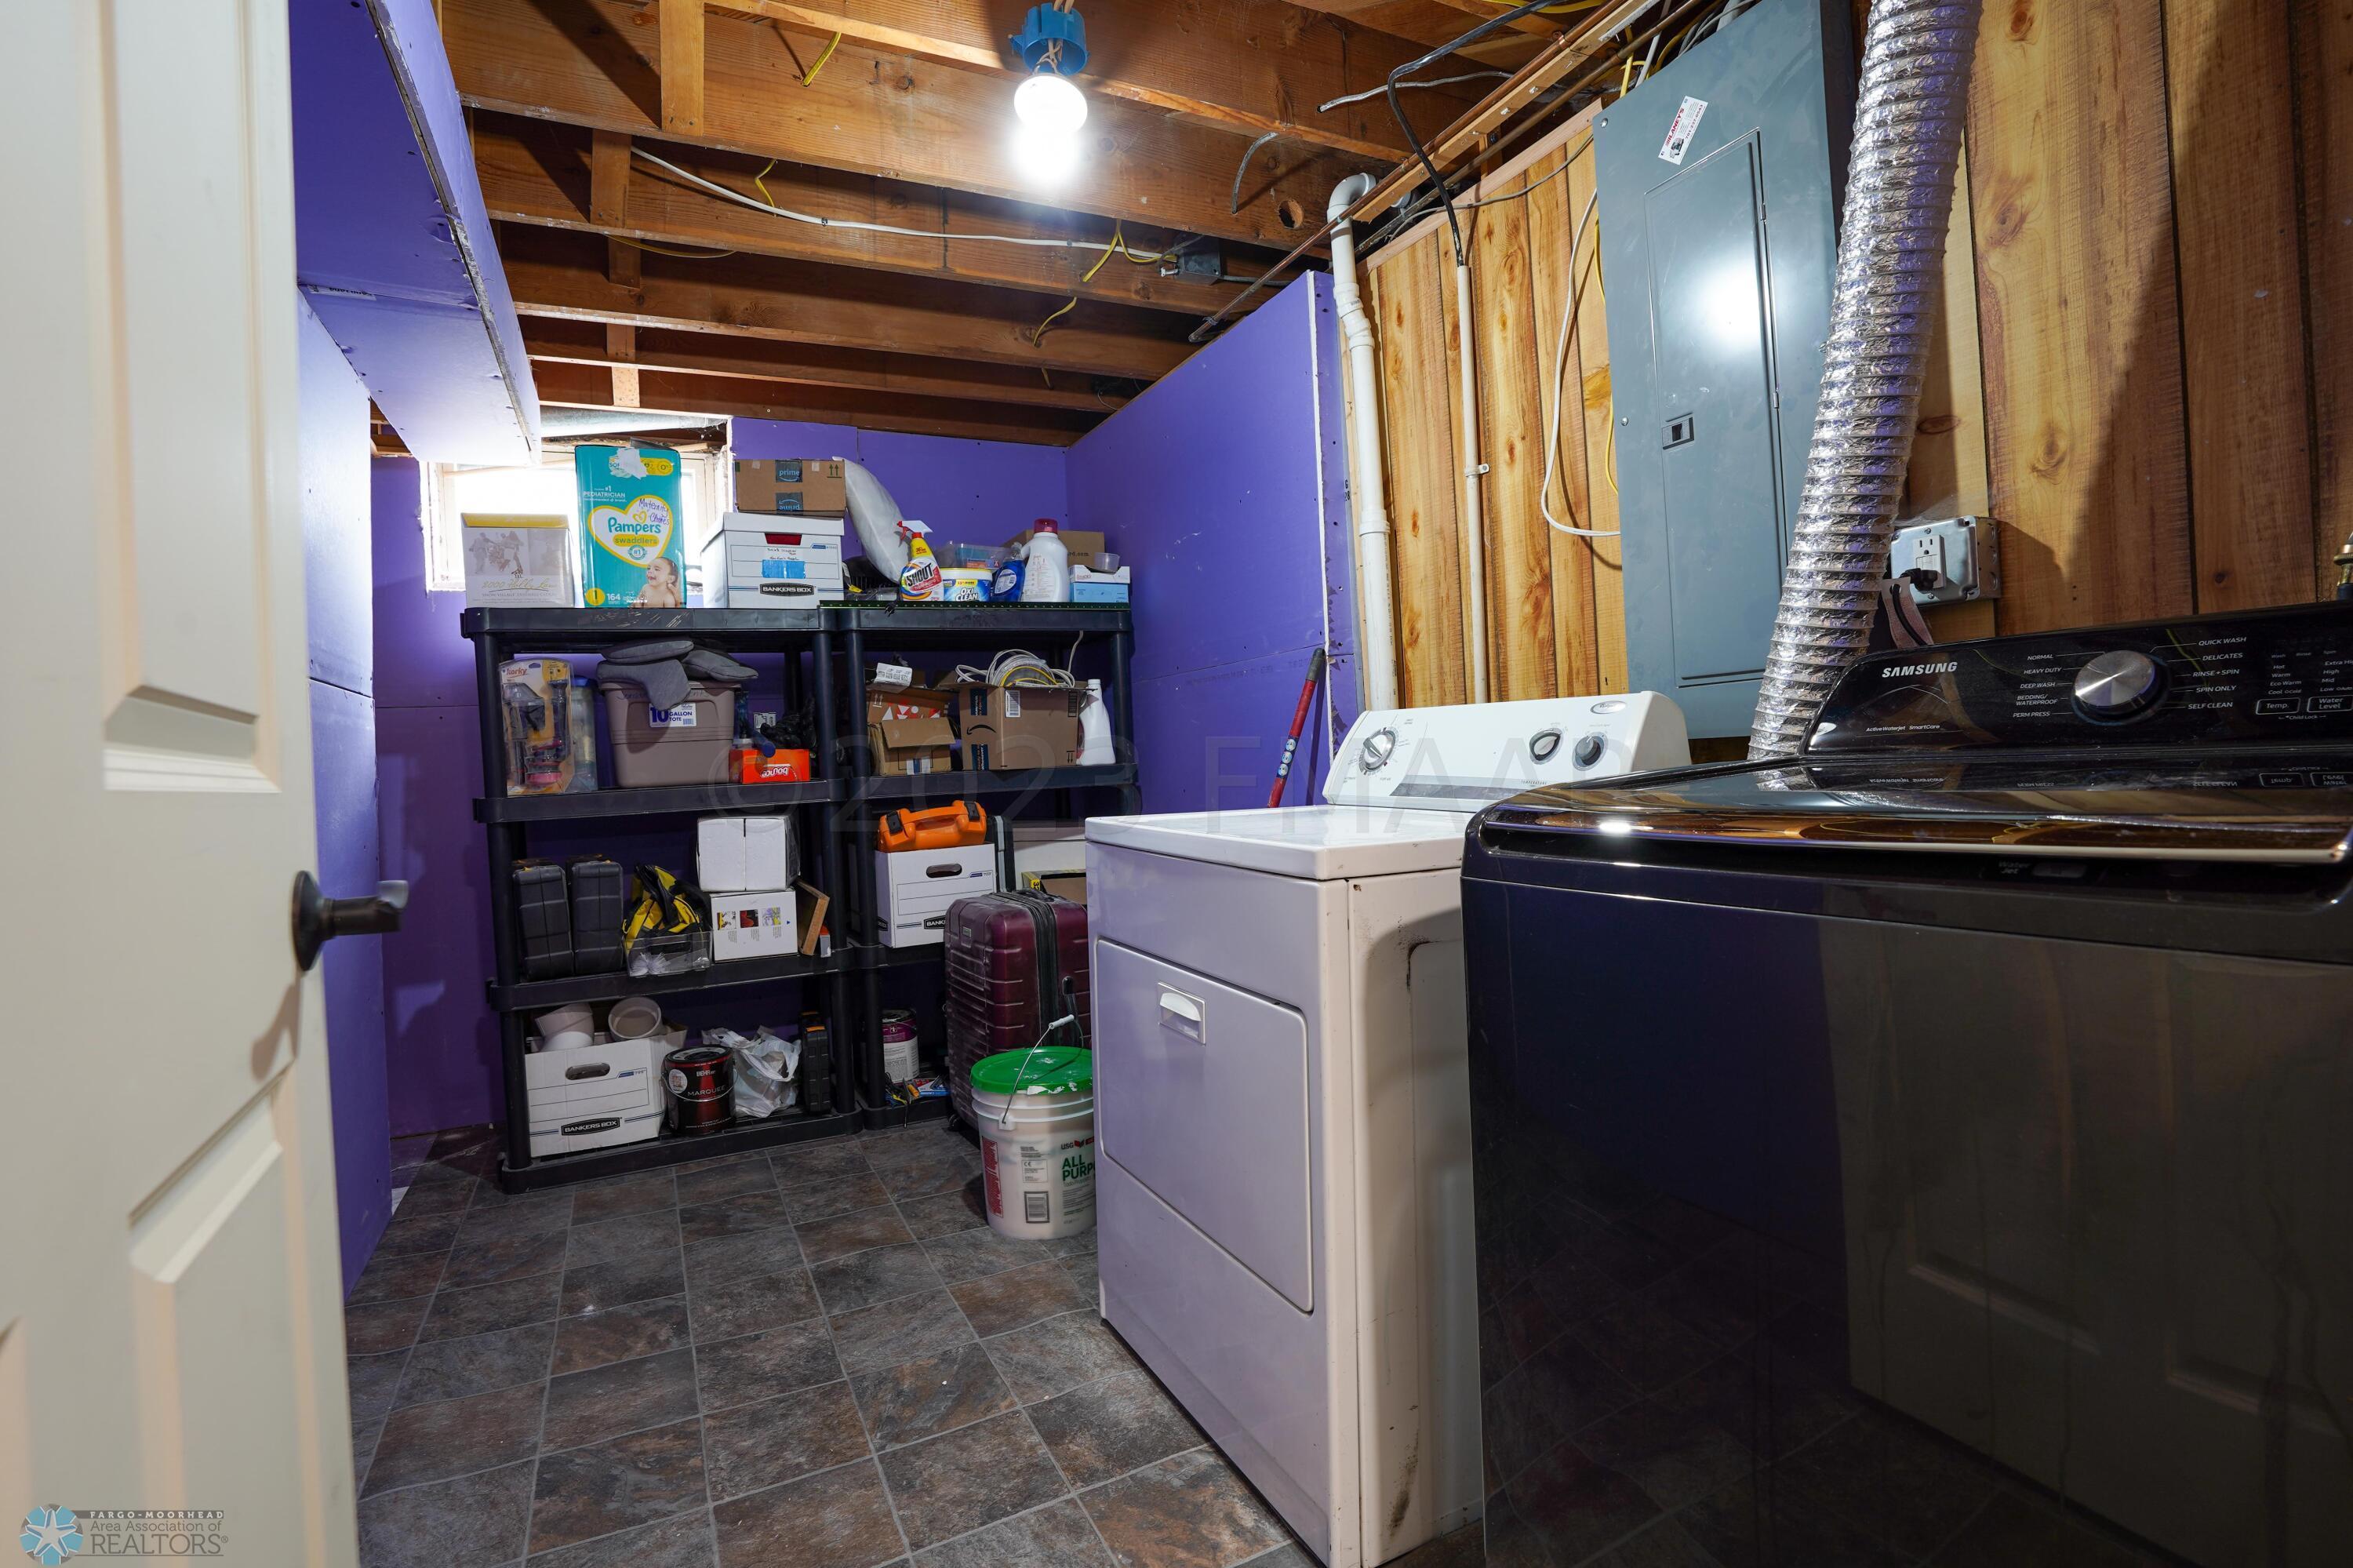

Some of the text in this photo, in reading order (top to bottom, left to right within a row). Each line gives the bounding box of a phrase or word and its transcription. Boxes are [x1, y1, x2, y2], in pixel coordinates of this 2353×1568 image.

[1667, 107, 1684, 139] LANEY'S
[779, 469, 800, 478] prime
[608, 516, 661, 535] Pampers
[906, 562, 933, 587] SHOUT
[2202, 653, 2243, 661] DELICATES
[1882, 661, 1958, 678] SAMSUNG
[650, 707, 669, 723] 10
[761, 766, 789, 778] bounce
[687, 1085, 726, 1097] MARQUEE
[565, 1122, 600, 1133] BANKERS
[1062, 1155, 1086, 1170] ALL
[1062, 1162, 1095, 1181] PURP
